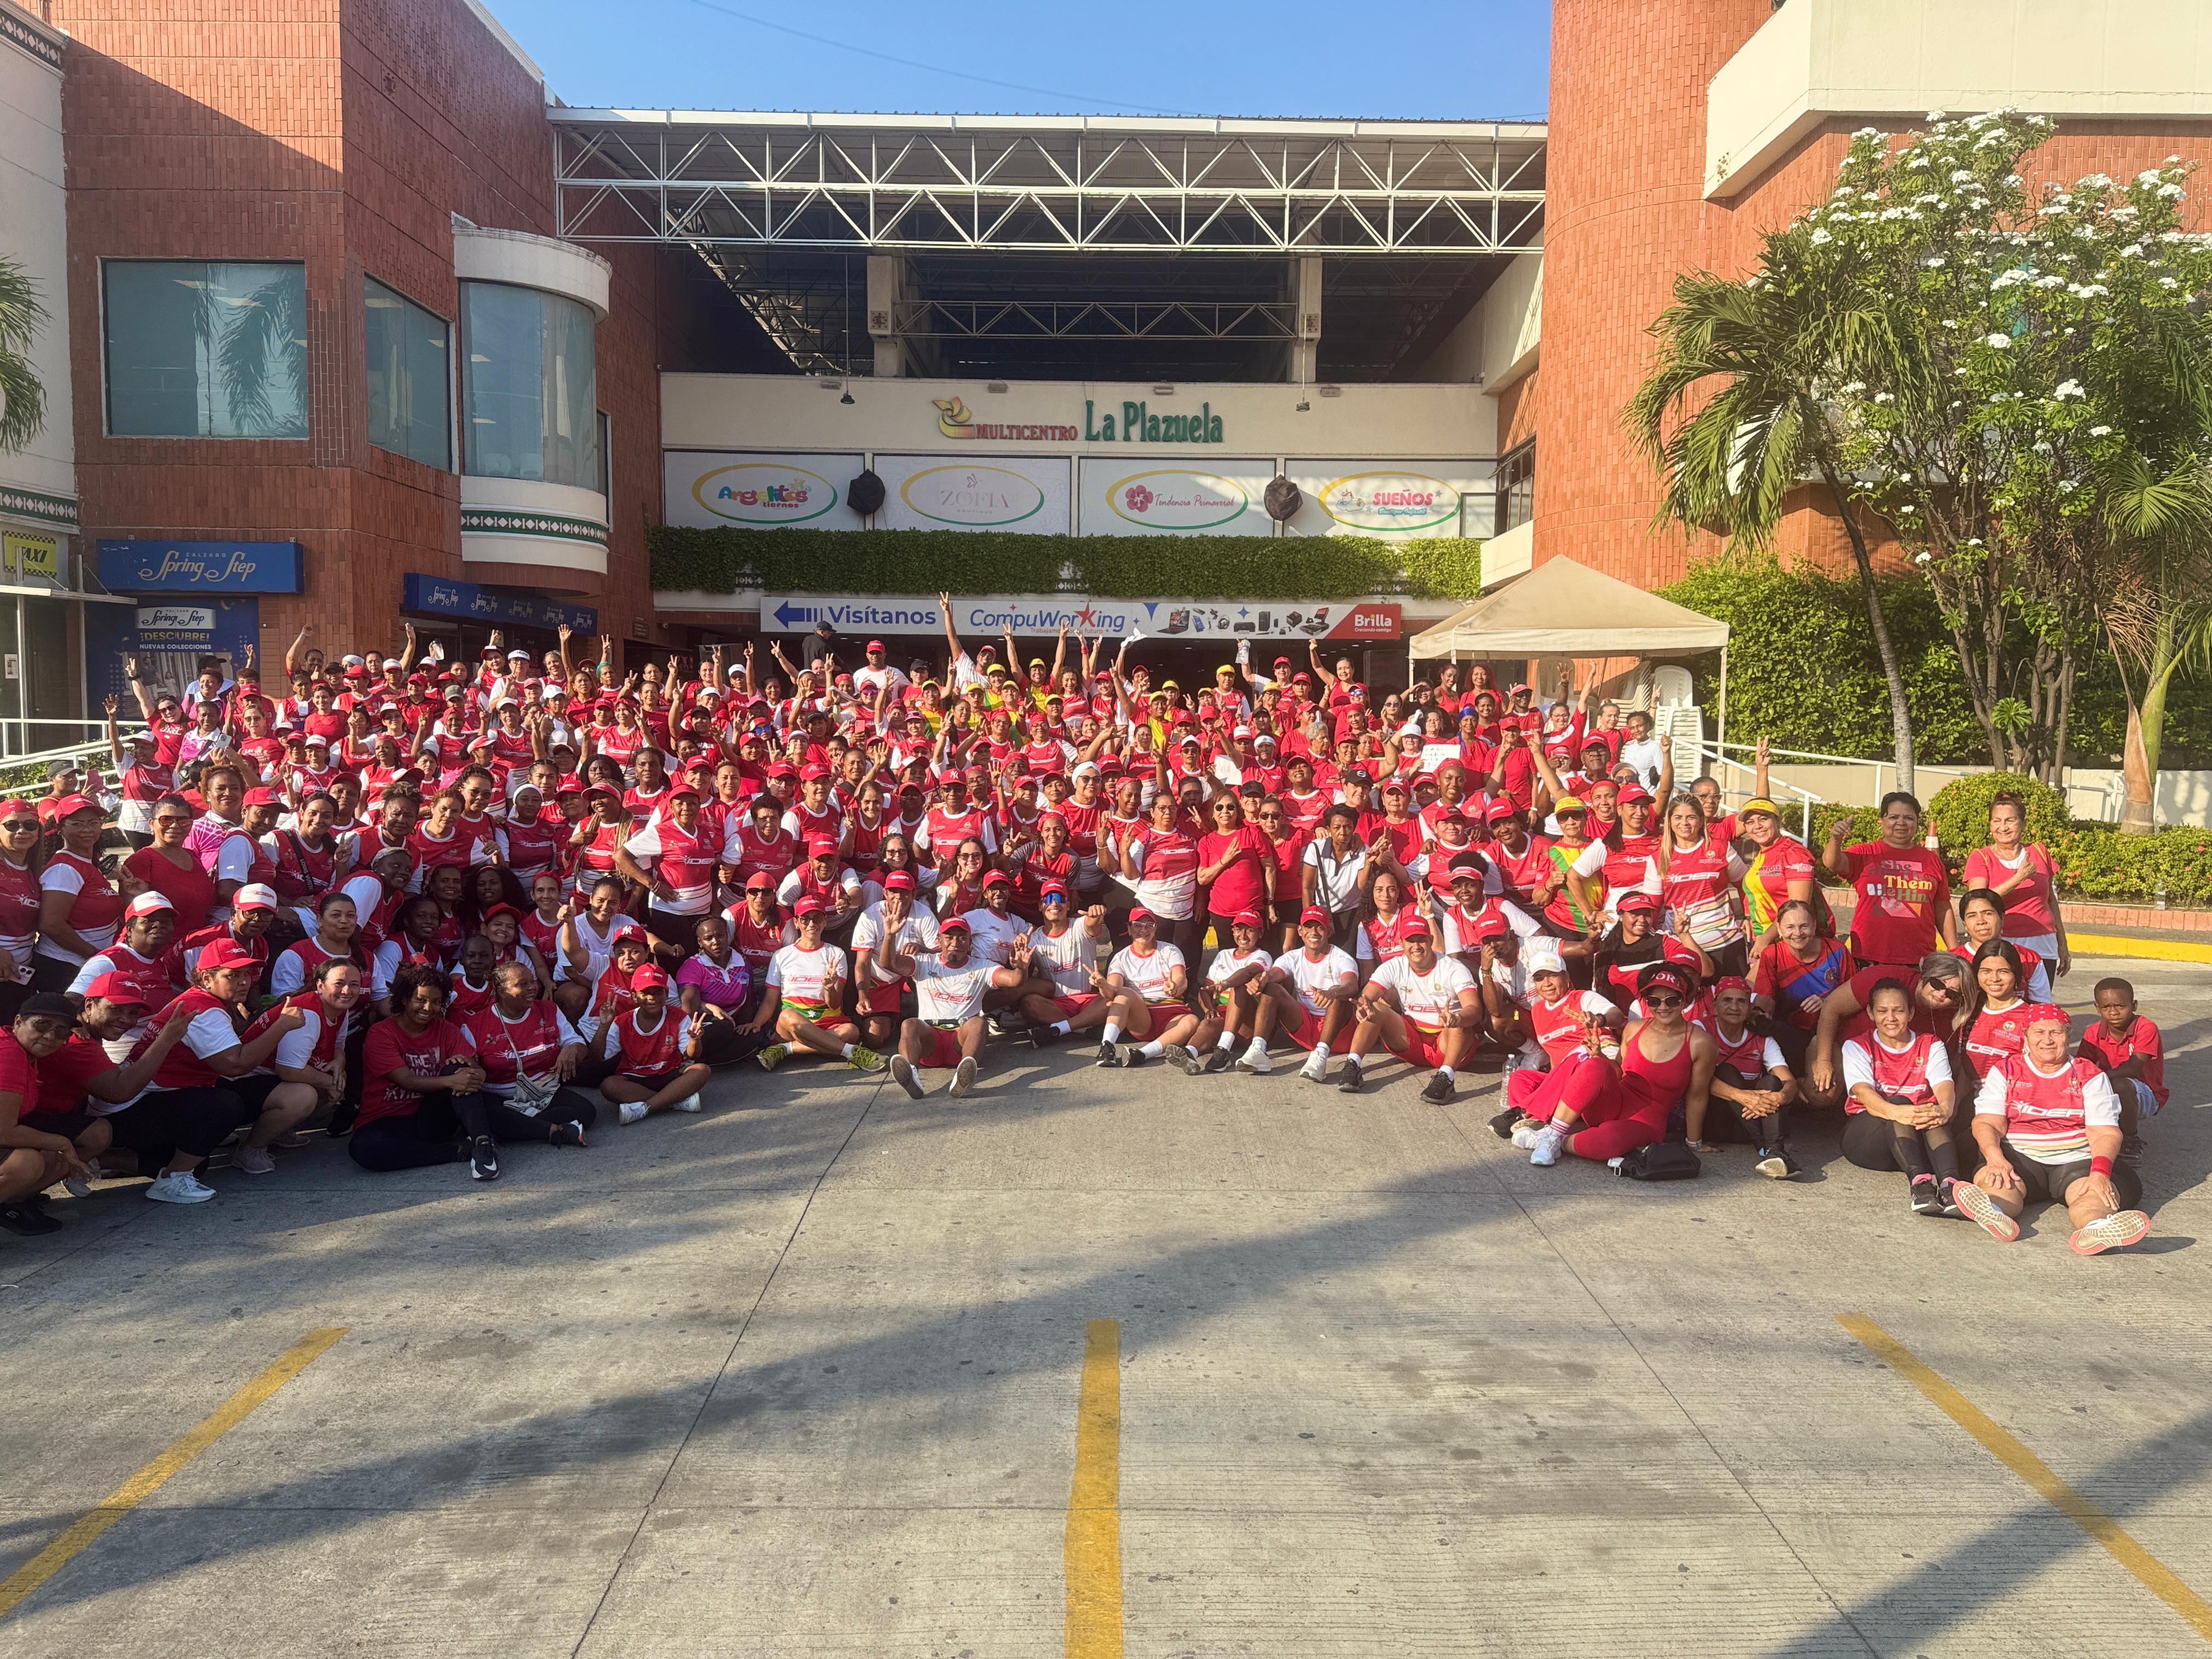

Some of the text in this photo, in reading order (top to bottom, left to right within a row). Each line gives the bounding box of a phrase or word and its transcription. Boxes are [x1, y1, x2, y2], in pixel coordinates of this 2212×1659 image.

[975, 399, 1223, 443] MULTICENTRO La Plazuela
[940, 490, 1011, 508] ZOFIA
[1154, 494, 1234, 508] Tendencia Primaveral
[1373, 489, 1433, 505] SUEÑOS
[138, 550, 256, 582] Spring Step
[141, 610, 205, 626] Spring Step
[827, 605, 936, 624] Visítanos
[1355, 614, 1392, 627] Brilla
[140, 631, 210, 641] ¡DESCUBRE!
[1881, 860, 1912, 871] She
[1673, 871, 1720, 883] IDER
[1883, 874, 1933, 890] Them
[1897, 889, 1928, 902] Him
[1539, 1024, 1577, 1043] IDER
[1966, 1042, 2010, 1058] IDER
[406, 1053, 432, 1068] THE
[1882, 1080, 1927, 1094] IDER
[2022, 1103, 2085, 1118] IDER
